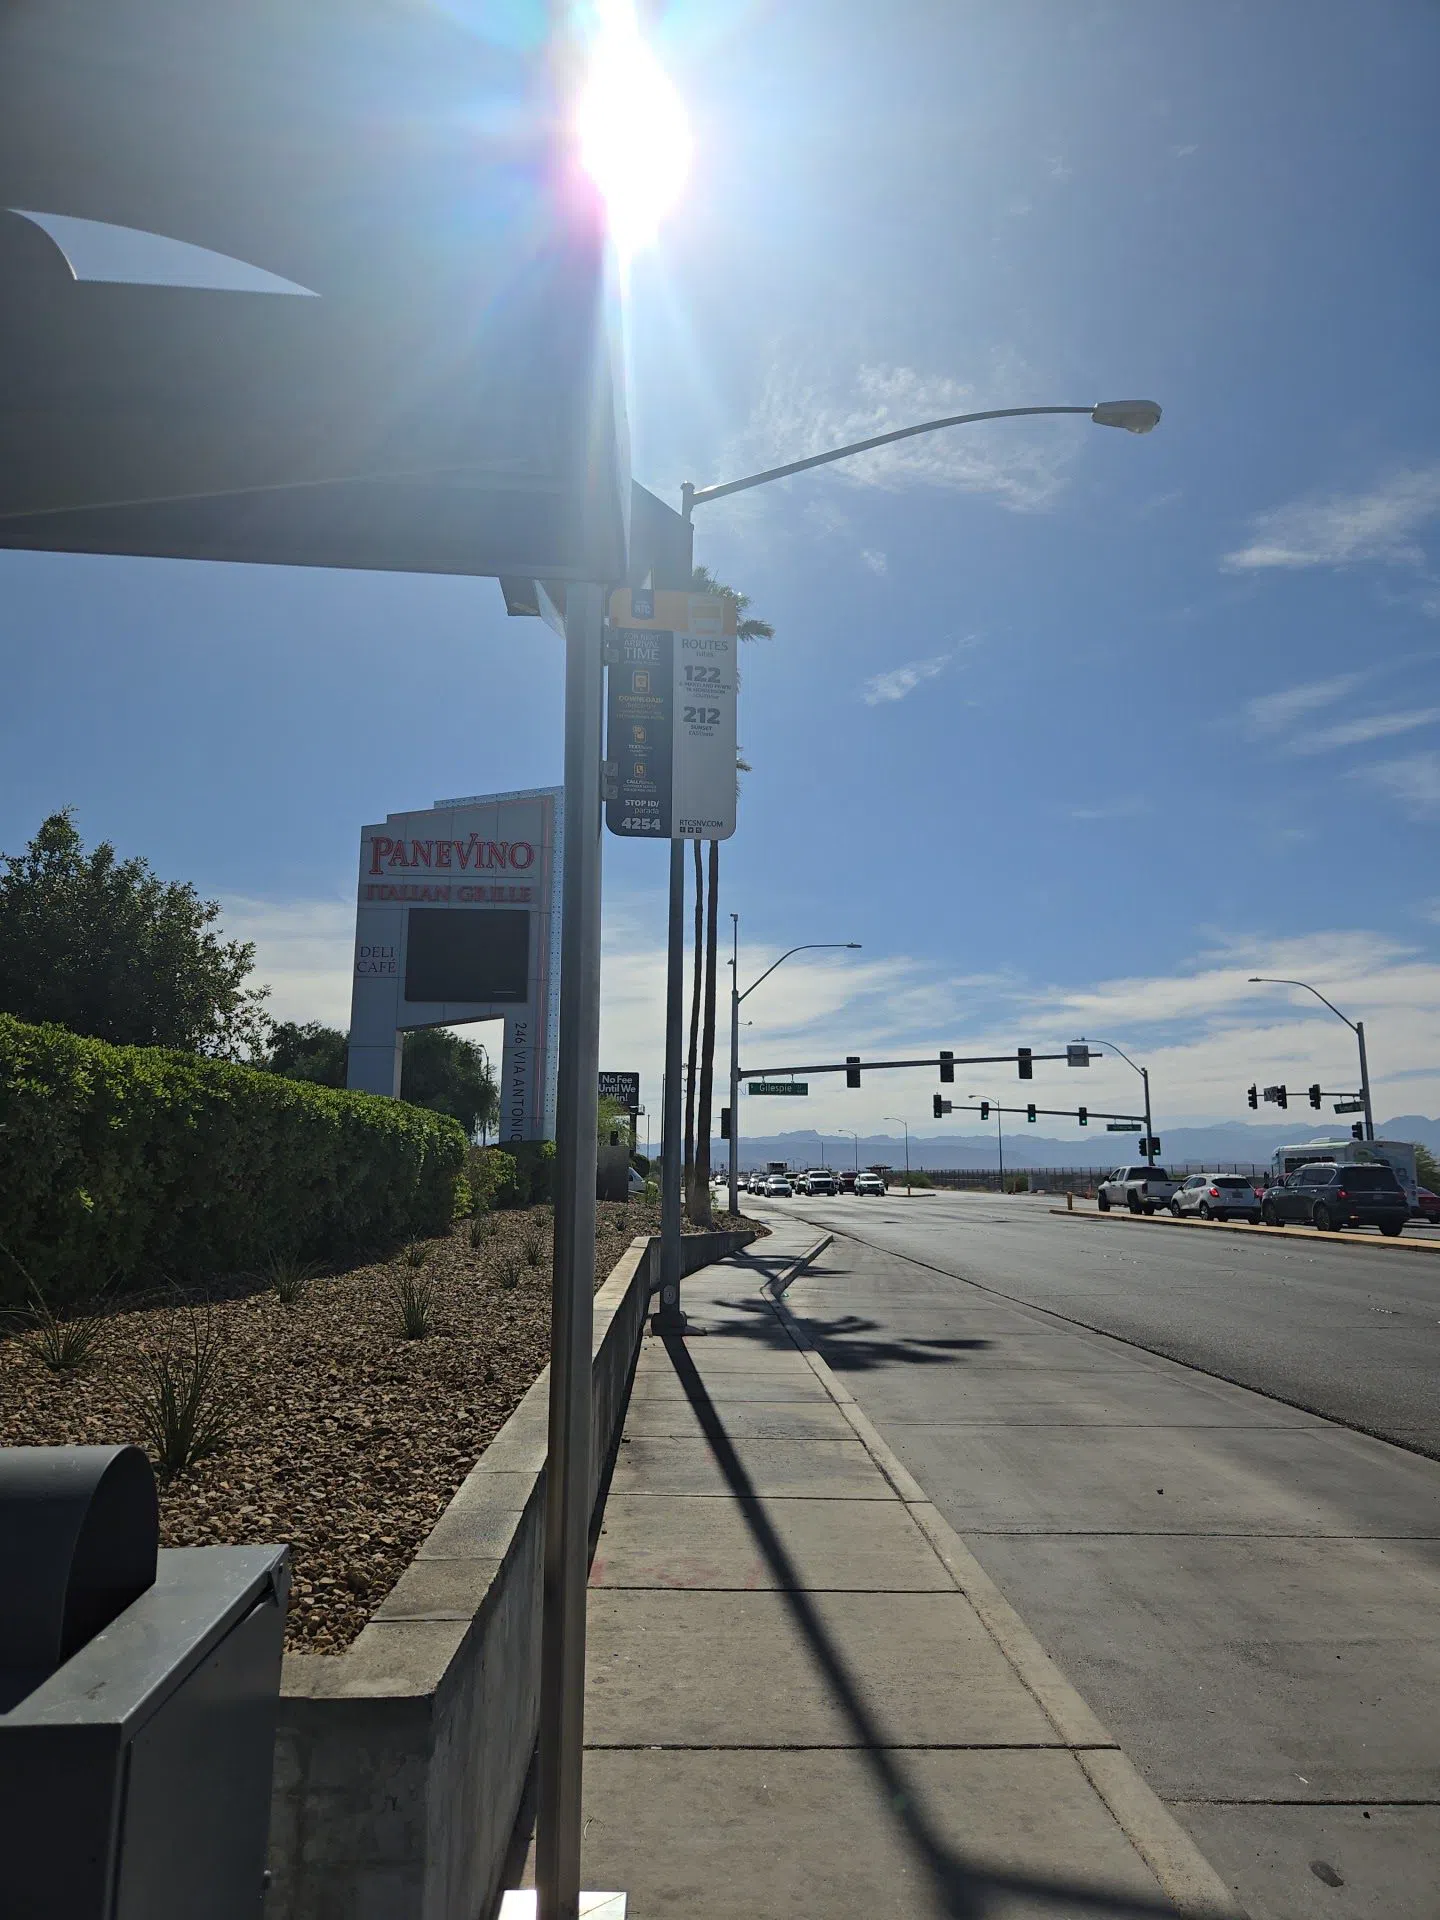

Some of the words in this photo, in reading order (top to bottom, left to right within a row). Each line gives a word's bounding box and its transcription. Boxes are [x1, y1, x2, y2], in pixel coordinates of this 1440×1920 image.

[624, 640, 660, 648] ARRIVAL
[681, 639, 729, 651] ROUTES
[624, 648, 660, 660] TIME
[684, 665, 720, 683] 122
[683, 706, 720, 724] 212
[634, 807, 660, 815] parada
[621, 817, 661, 830] 4254
[680, 819, 723, 828] RTCSNV.COM
[369, 832, 535, 875] PANEVINO
[366, 884, 449, 900] ITALIAN
[457, 885, 533, 902] GRILLE
[360, 946, 395, 958] DELI
[356, 959, 397, 973] CAFÉ
[514, 1022, 528, 1044] 246
[513, 1051, 526, 1075] VIA
[602, 1074, 616, 1083] No
[617, 1074, 633, 1084] Fee
[598, 1083, 620, 1092] Until
[620, 1084, 636, 1093] We
